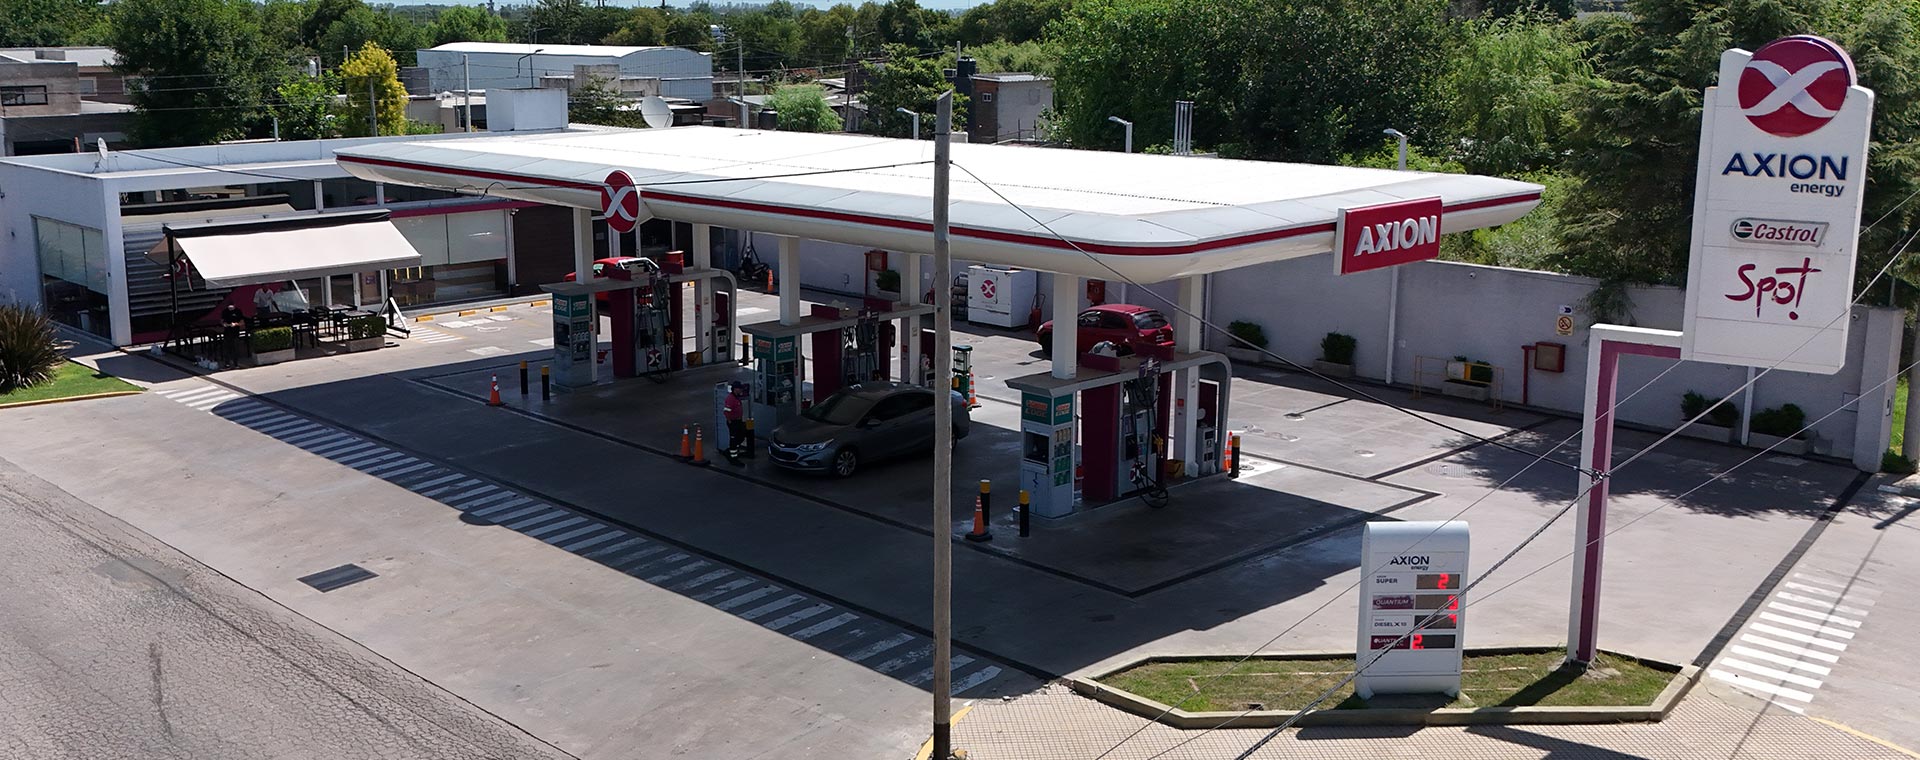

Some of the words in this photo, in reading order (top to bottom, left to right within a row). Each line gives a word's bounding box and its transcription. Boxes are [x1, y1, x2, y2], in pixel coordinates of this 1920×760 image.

[1721, 152, 1848, 181] AXION
[1790, 182, 1844, 197] energy
[1353, 215, 1438, 257] AXION
[1754, 222, 1819, 243] Castrol
[1390, 556, 1430, 565] AXION
[1438, 573, 1449, 590] 2
